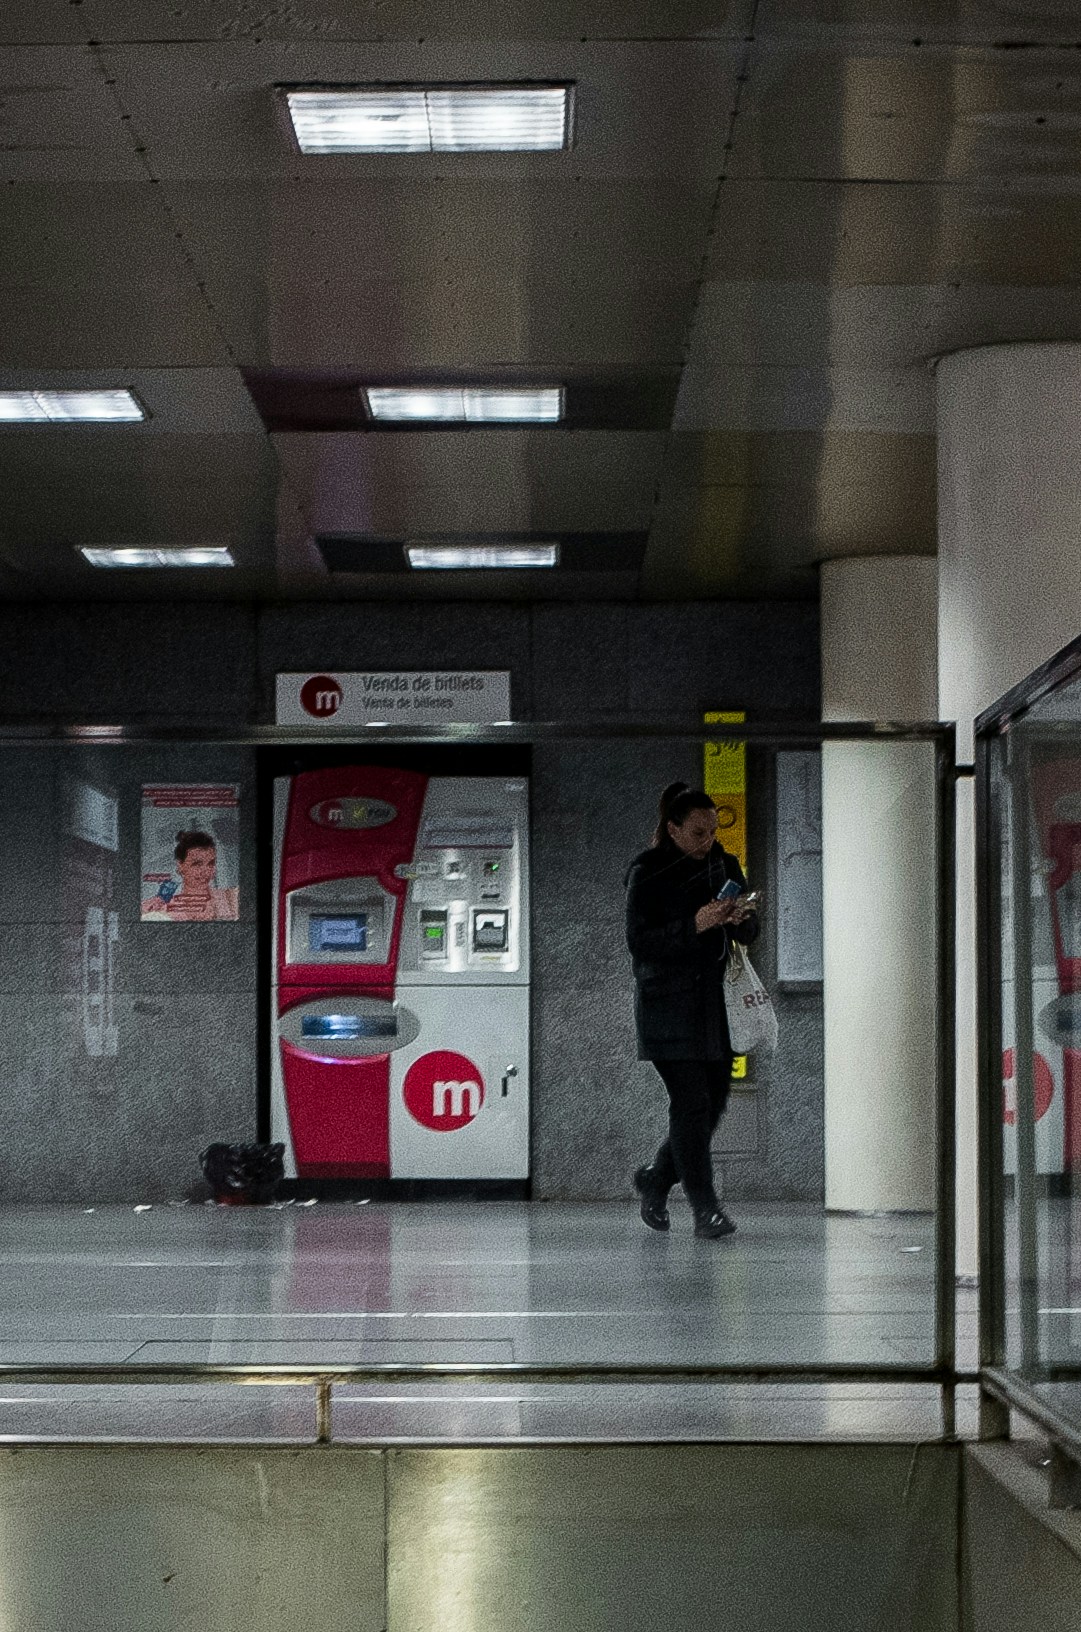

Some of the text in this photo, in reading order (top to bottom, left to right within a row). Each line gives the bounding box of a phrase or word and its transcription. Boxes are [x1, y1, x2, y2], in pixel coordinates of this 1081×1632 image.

[361, 676, 408, 691] Venda
[412, 676, 431, 691] de
[315, 690, 340, 711] m
[397, 697, 410, 709] de
[432, 1079, 480, 1116] m
